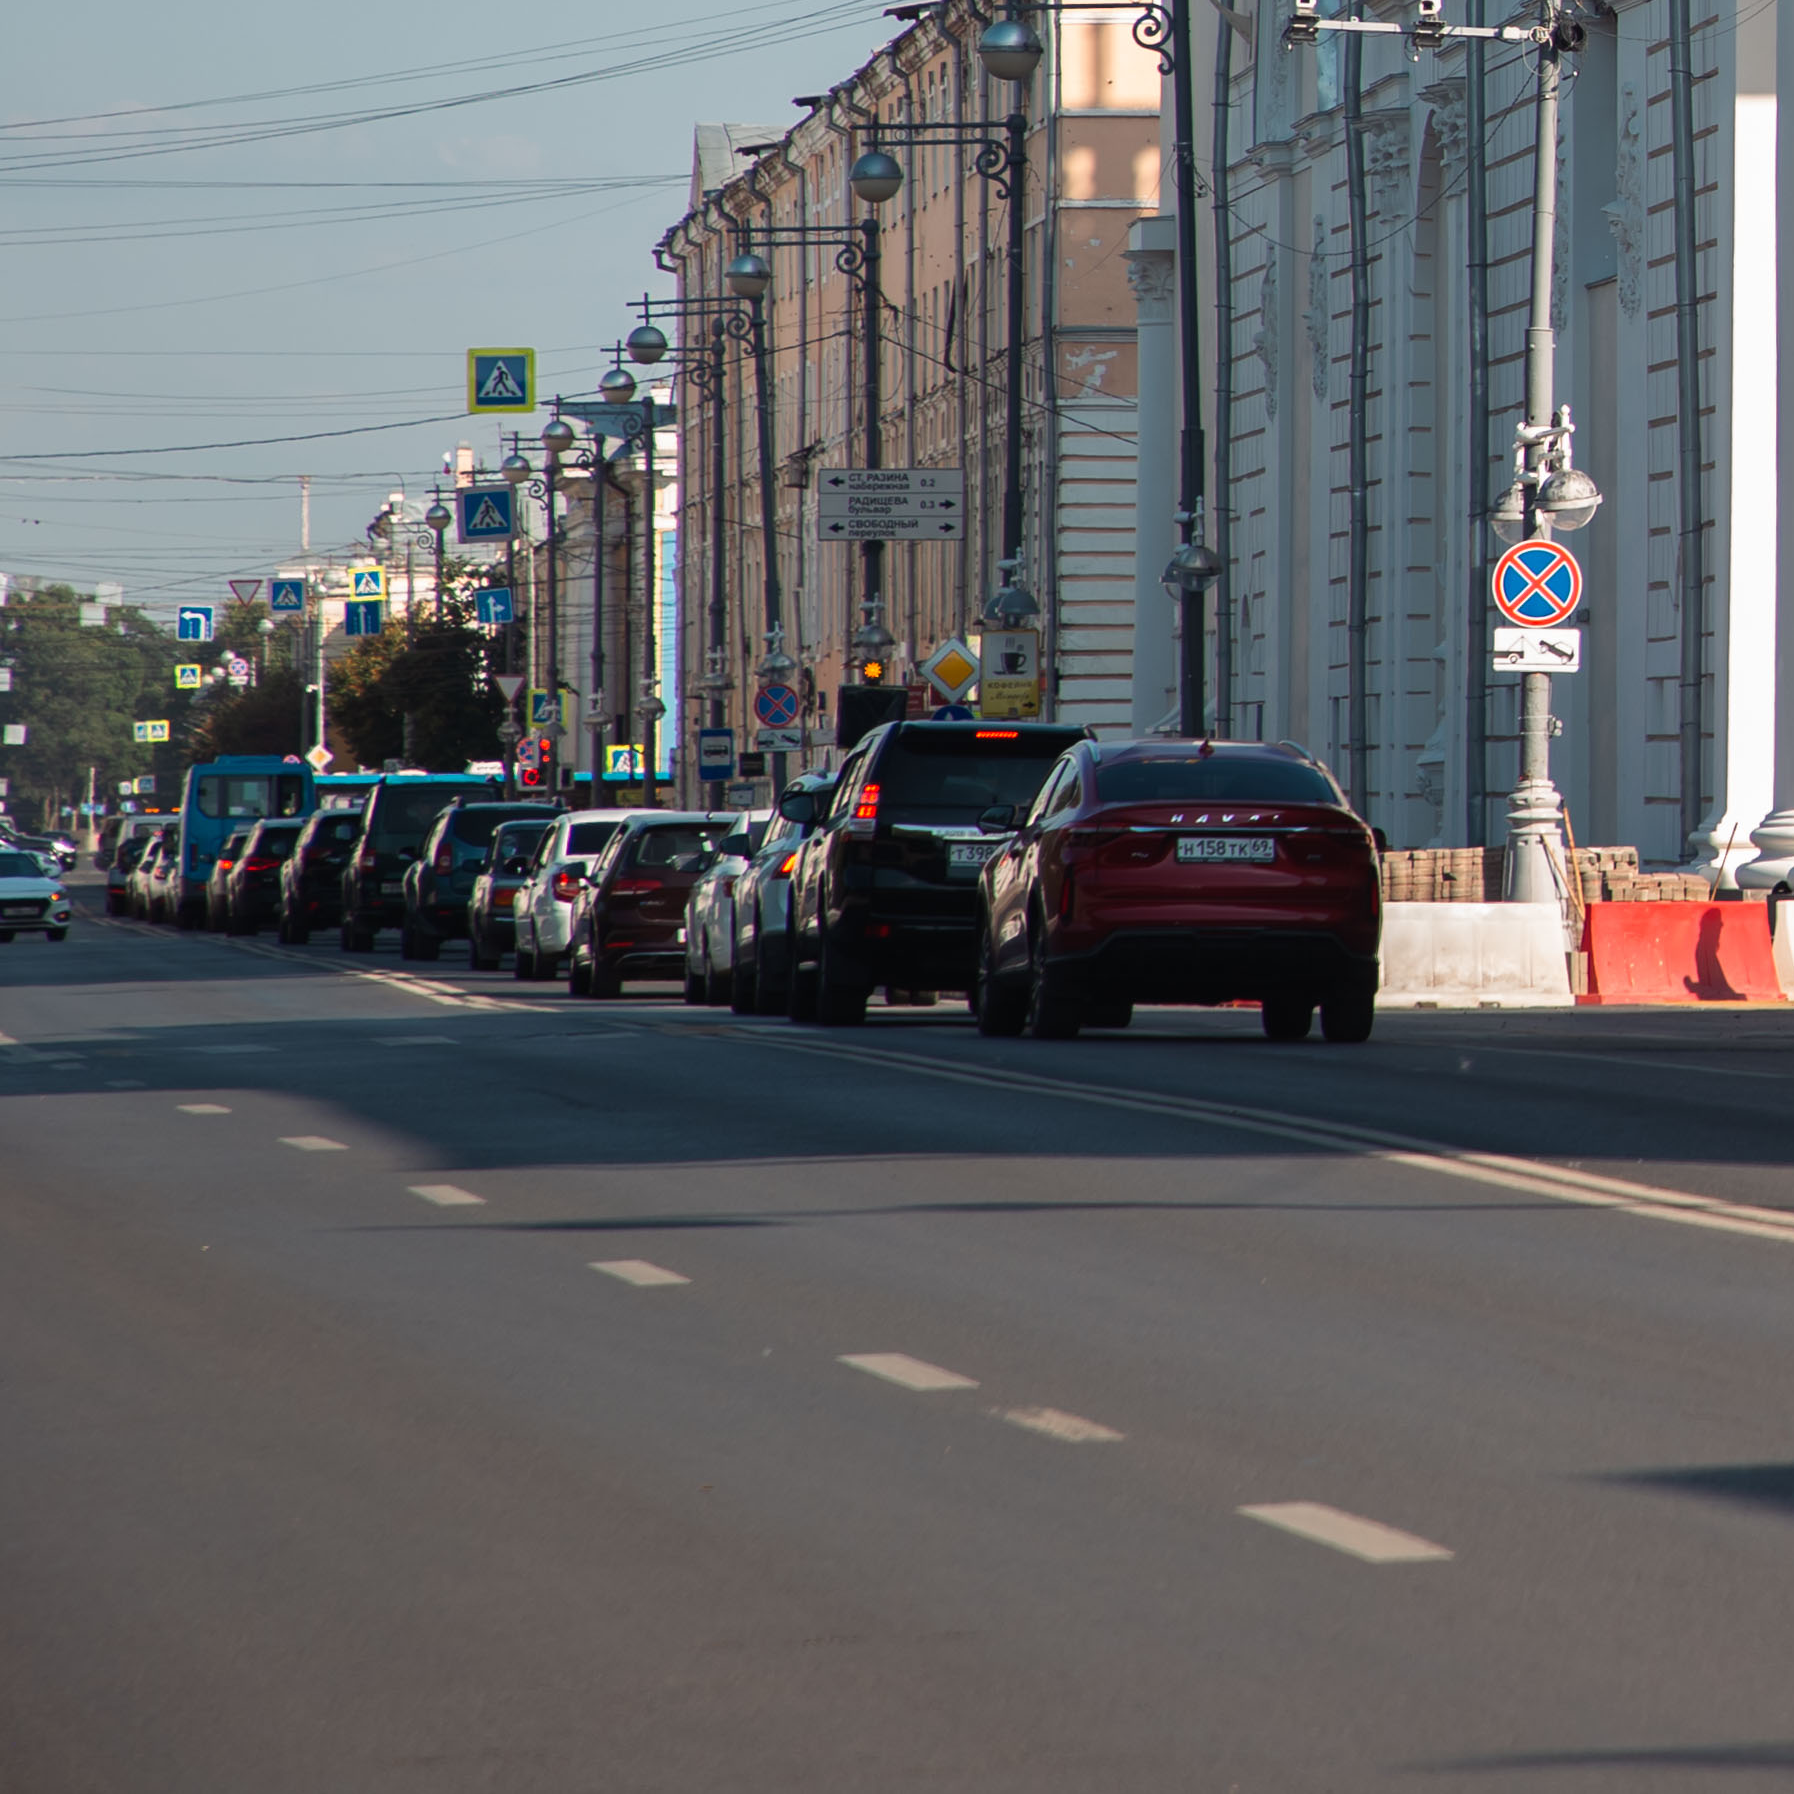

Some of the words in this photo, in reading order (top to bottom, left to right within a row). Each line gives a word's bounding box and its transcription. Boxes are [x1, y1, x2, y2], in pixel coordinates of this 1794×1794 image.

[867, 473, 909, 482] РАЗИНА
[848, 482, 911, 491] набережная
[920, 478, 936, 487] 0.2
[848, 496, 909, 506] РАДИЩЕВА
[848, 505, 893, 514] бульвар
[848, 519, 919, 529] СВОБОДНЫЙ
[848, 529, 897, 538] переулок
